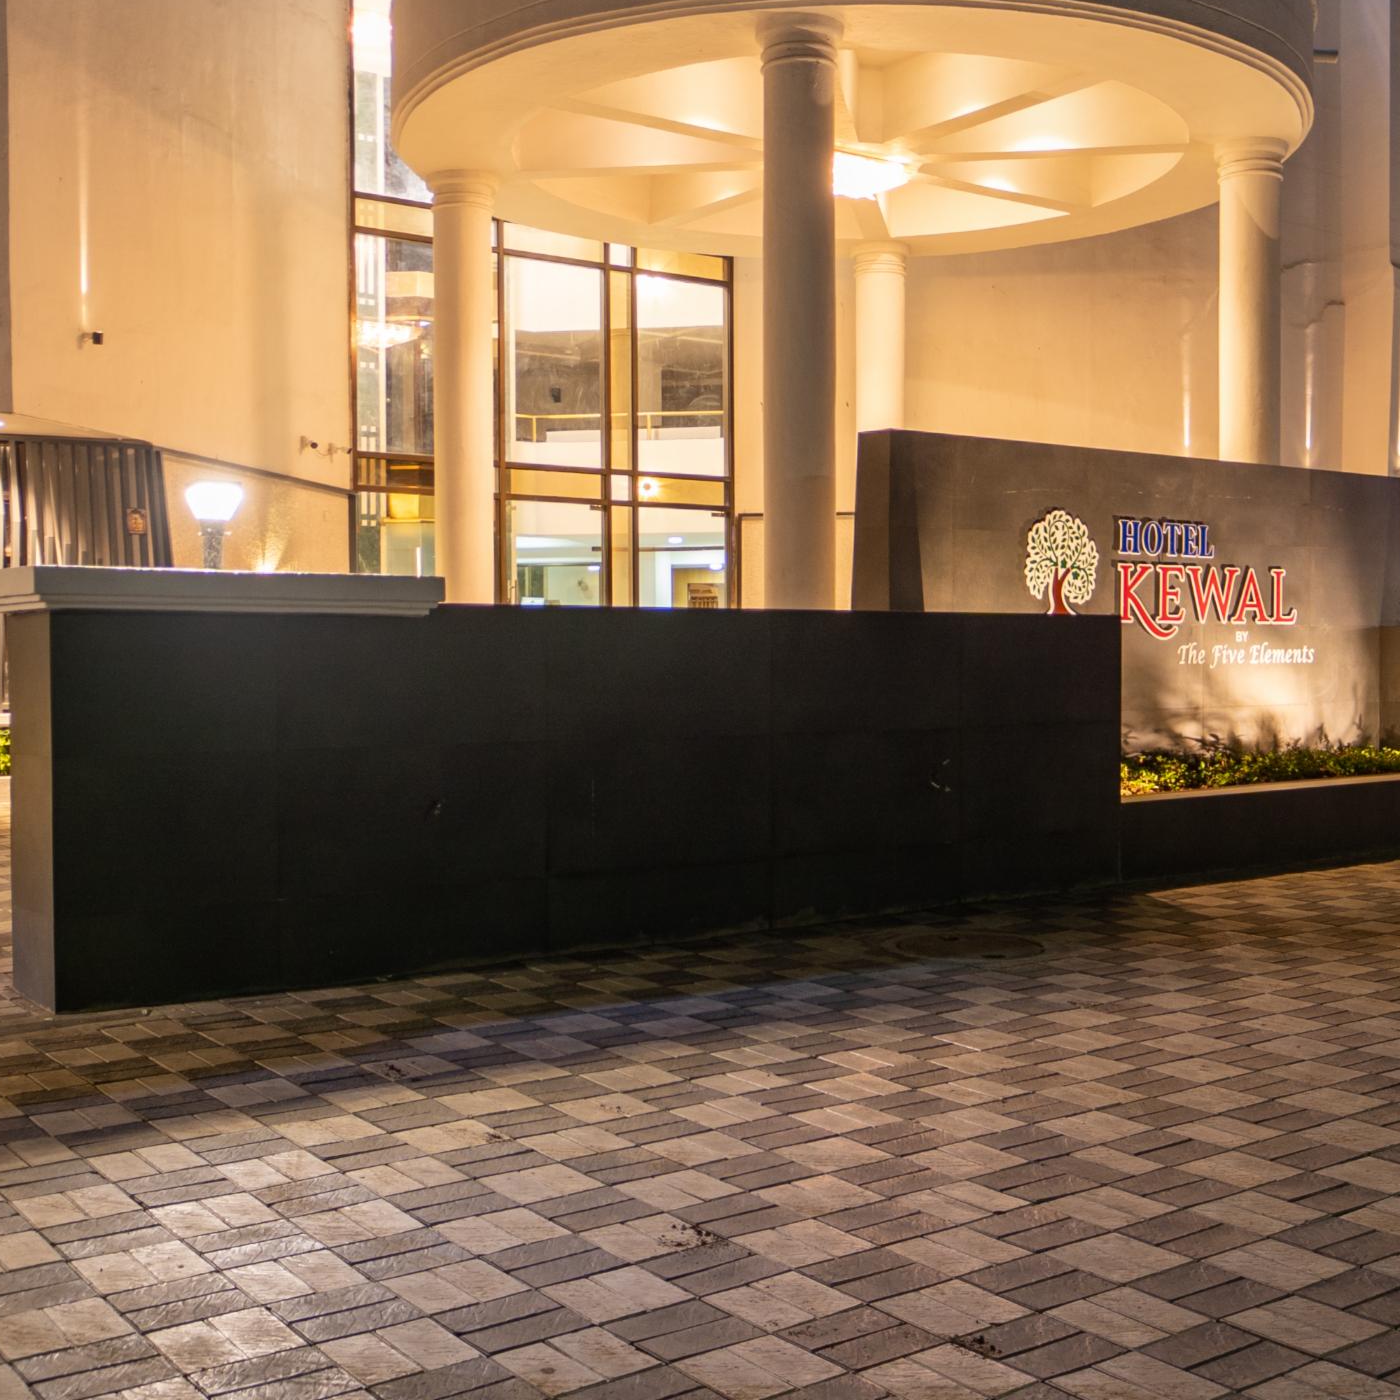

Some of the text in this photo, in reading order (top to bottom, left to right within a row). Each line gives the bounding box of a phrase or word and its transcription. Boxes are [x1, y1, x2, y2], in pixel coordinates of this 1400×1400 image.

[1118, 518, 1215, 559] HOTEL
[1117, 563, 1298, 641] KEWAL
[1235, 631, 1249, 643] BY
[1177, 642, 1315, 669] The Five Elements
